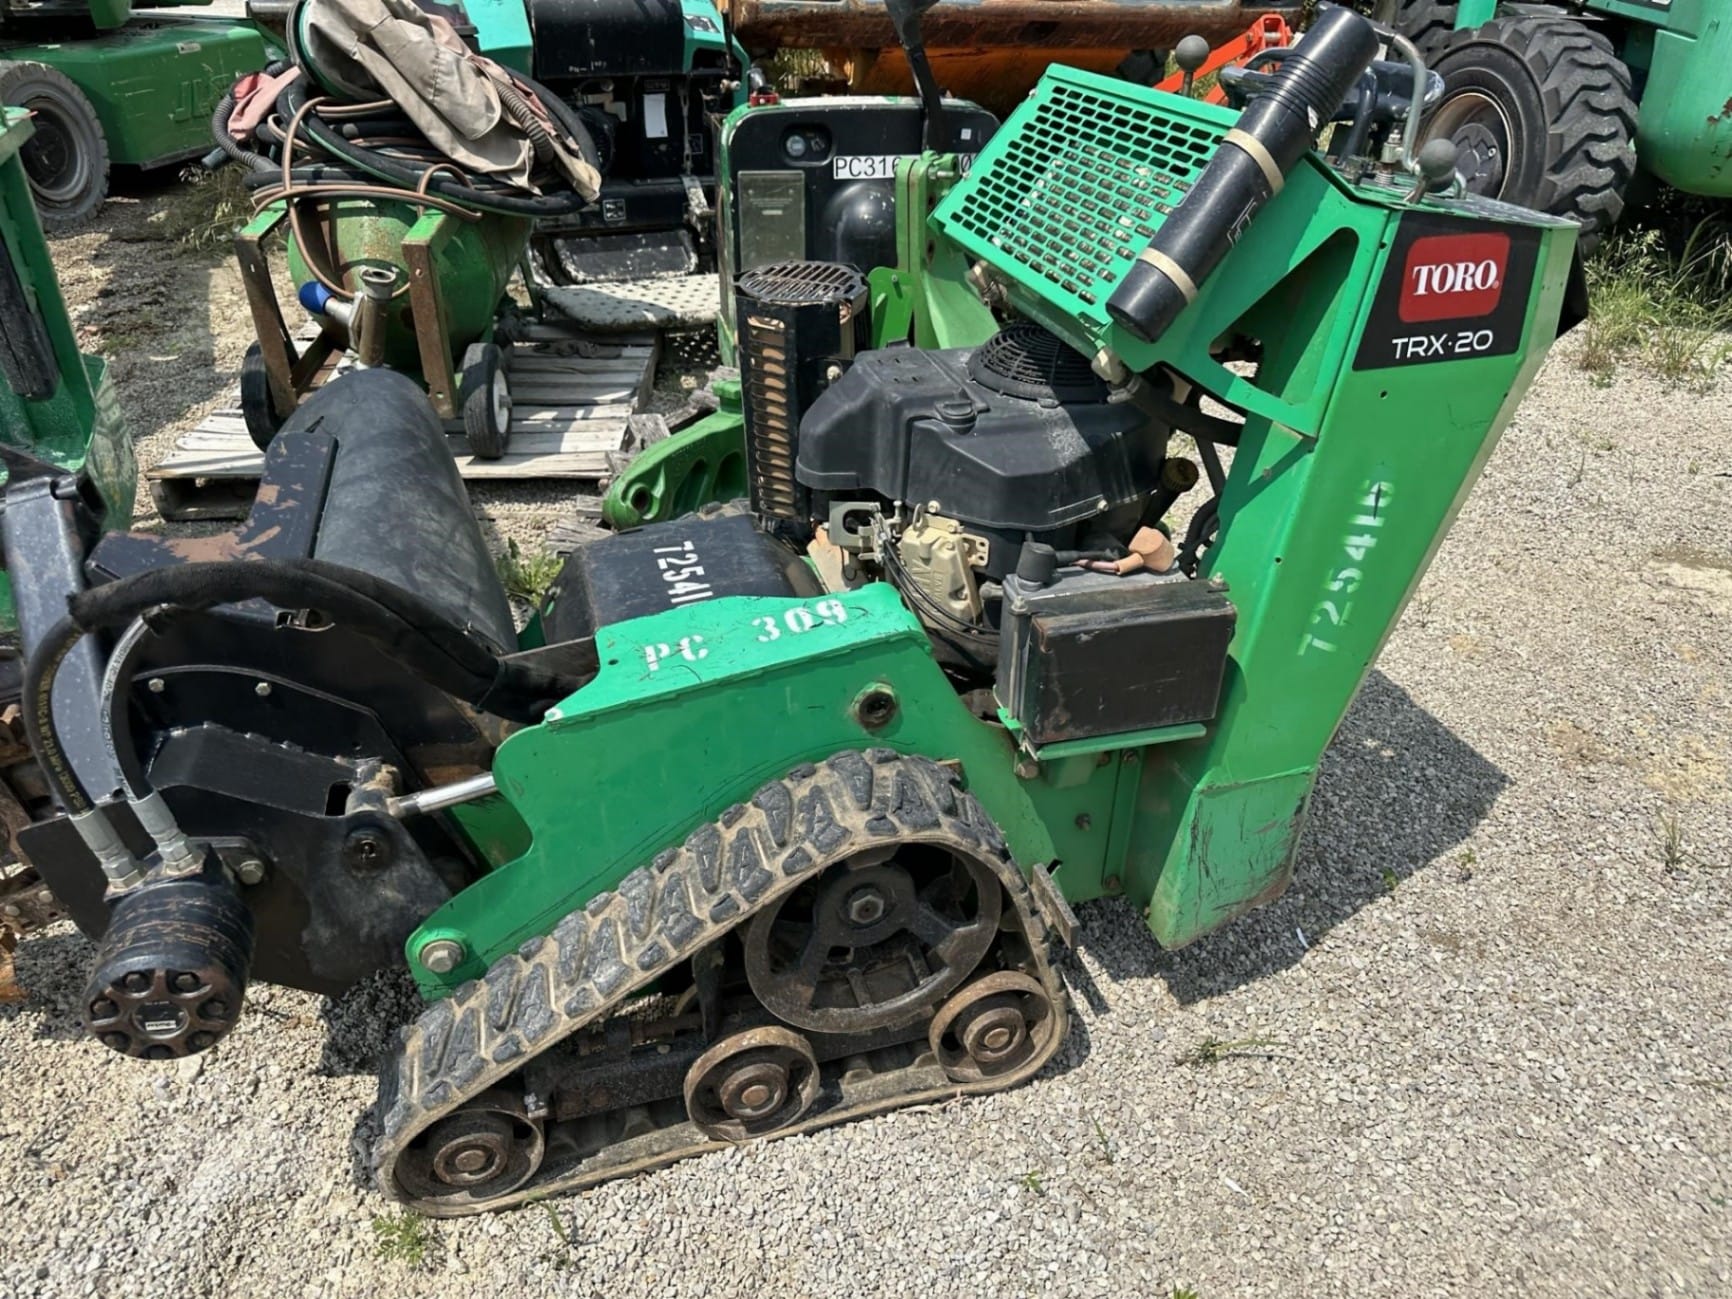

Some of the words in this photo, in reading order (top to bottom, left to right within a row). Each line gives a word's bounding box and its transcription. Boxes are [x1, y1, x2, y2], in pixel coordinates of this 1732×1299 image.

[1412, 259, 1498, 296] TORO
[644, 634, 709, 672] PC
[751, 599, 848, 643] 309
